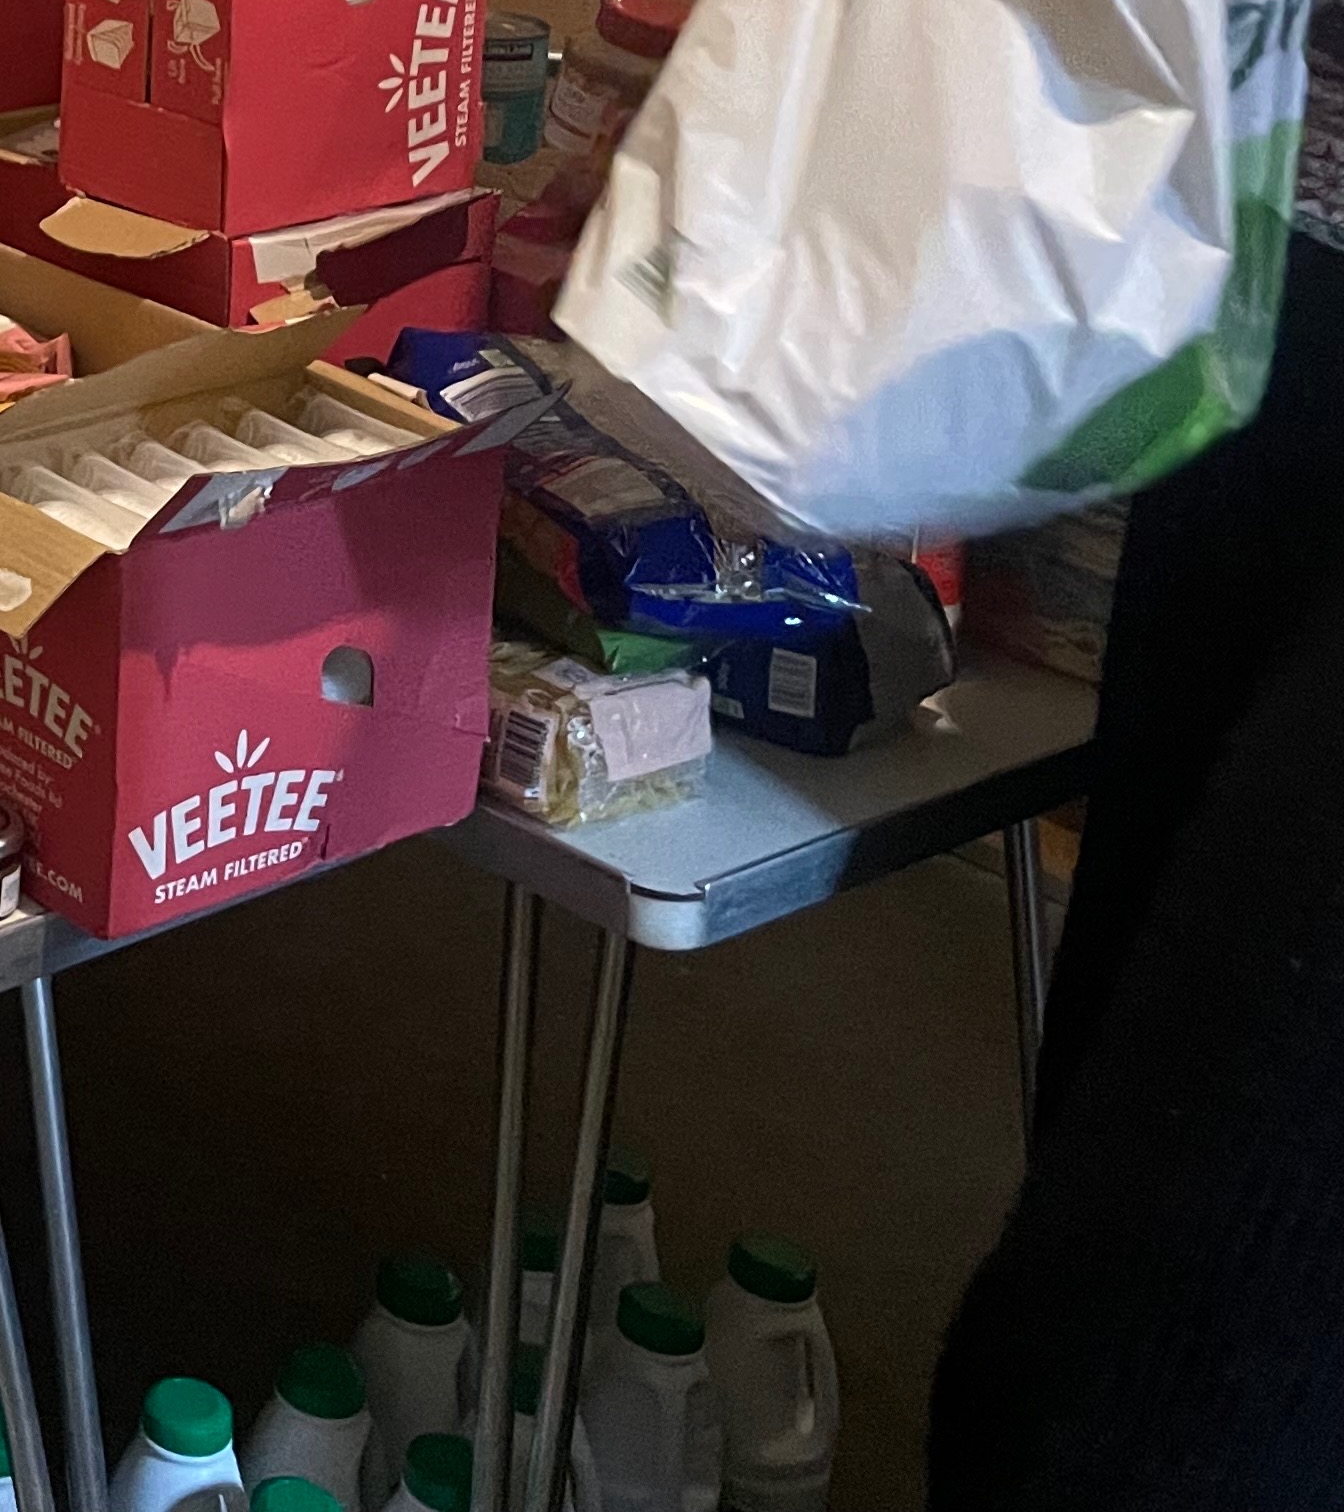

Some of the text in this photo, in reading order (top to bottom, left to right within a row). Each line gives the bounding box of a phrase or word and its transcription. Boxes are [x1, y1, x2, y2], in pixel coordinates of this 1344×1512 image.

[454, 78, 471, 147] STEAM
[18, 726, 72, 770] FILTERED
[128, 769, 338, 881] VEETEE
[155, 839, 304, 904] STEAM FILTERED
